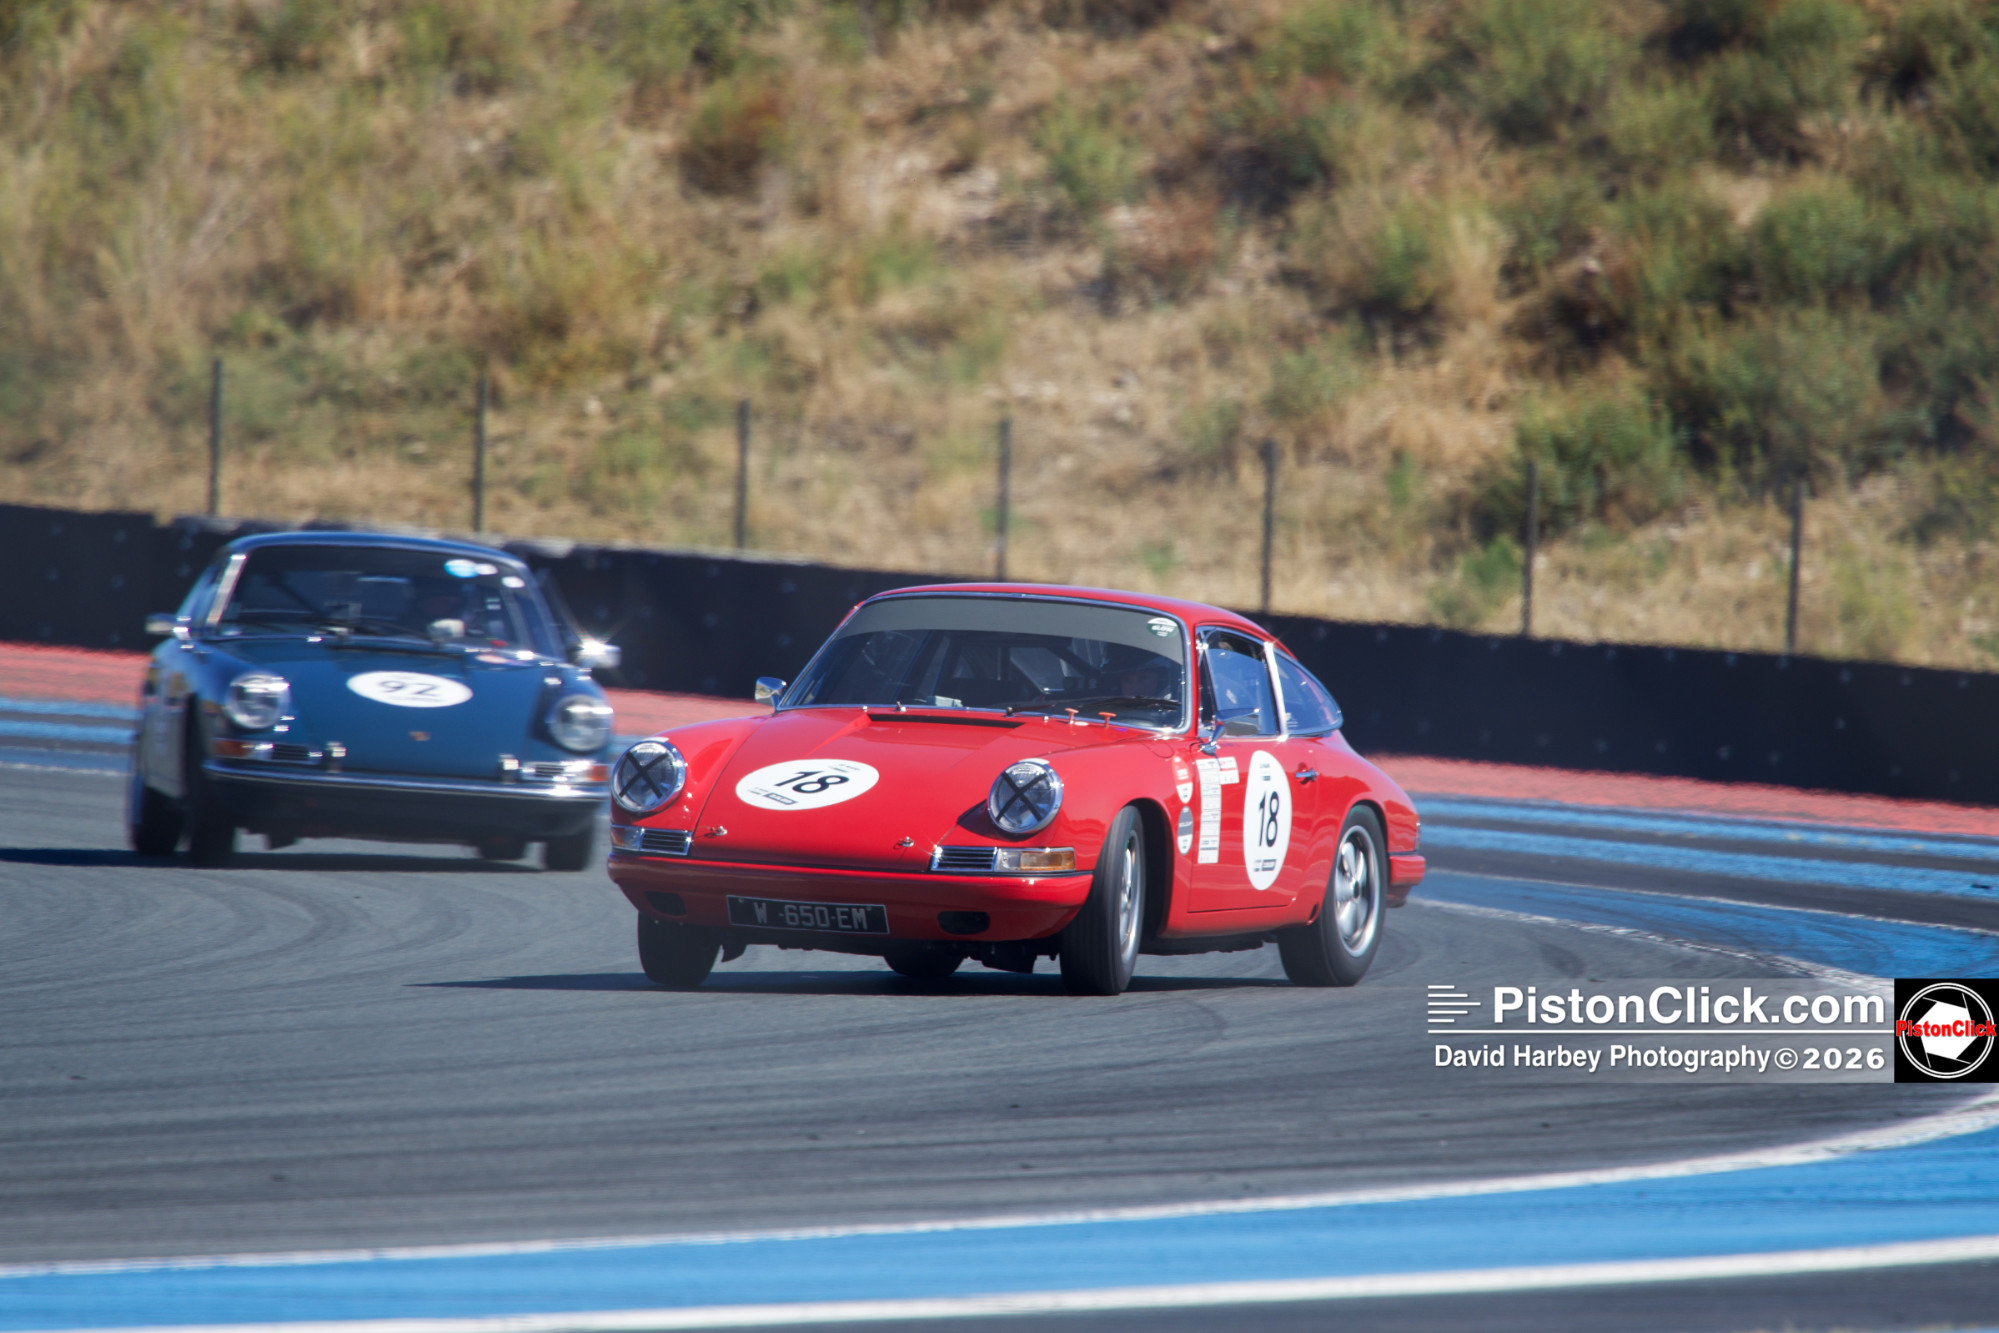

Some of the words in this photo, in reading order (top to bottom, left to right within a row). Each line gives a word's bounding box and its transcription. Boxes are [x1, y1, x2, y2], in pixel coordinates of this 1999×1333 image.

[378, 680, 438, 697] 92
[774, 770, 850, 794] 18
[1258, 791, 1280, 848] 18
